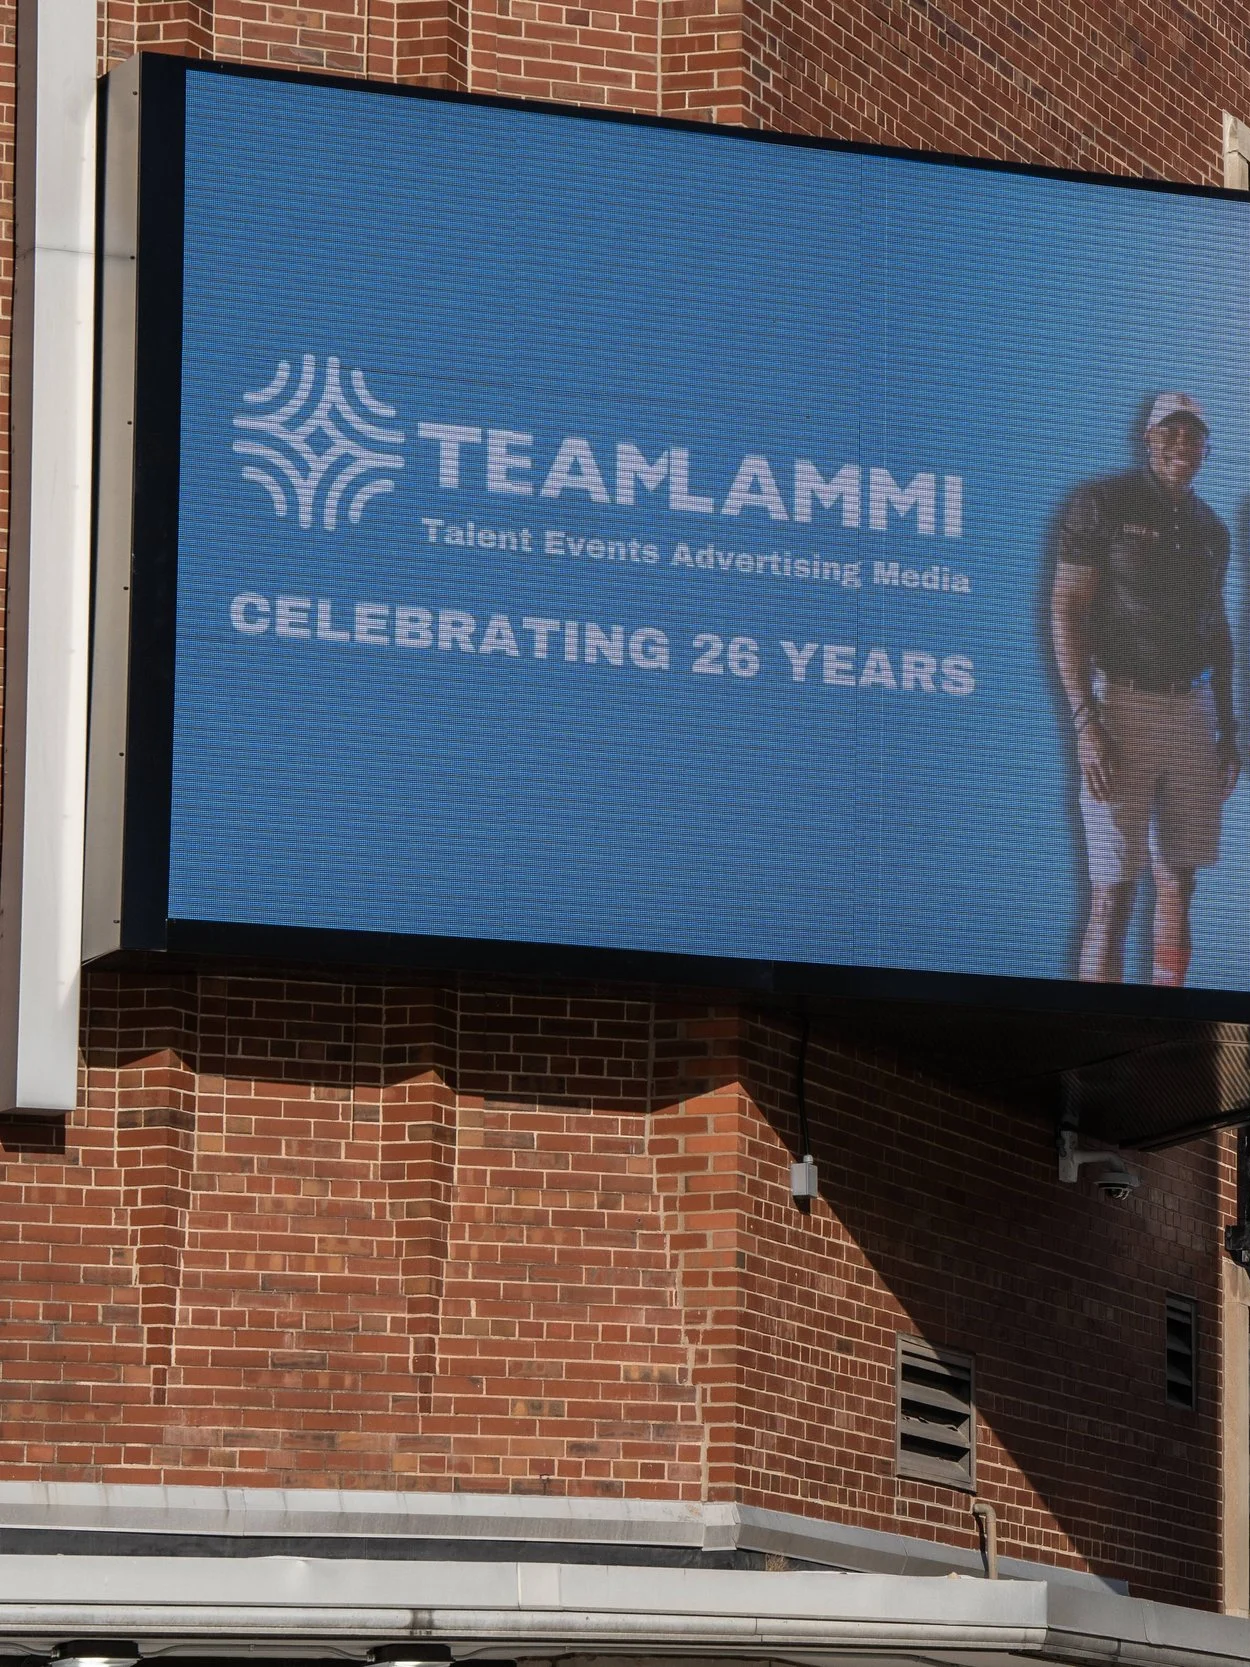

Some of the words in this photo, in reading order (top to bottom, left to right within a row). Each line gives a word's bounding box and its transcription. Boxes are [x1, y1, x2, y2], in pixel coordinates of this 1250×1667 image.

[418, 422, 963, 537] TEAMLAMMI
[421, 517, 532, 552] Talent
[545, 530, 659, 564] Events
[671, 543, 862, 588] Advertising
[873, 561, 971, 593] Media
[230, 593, 669, 669] CELEBRATING
[692, 634, 759, 677] 26
[781, 641, 975, 695] YEARS
